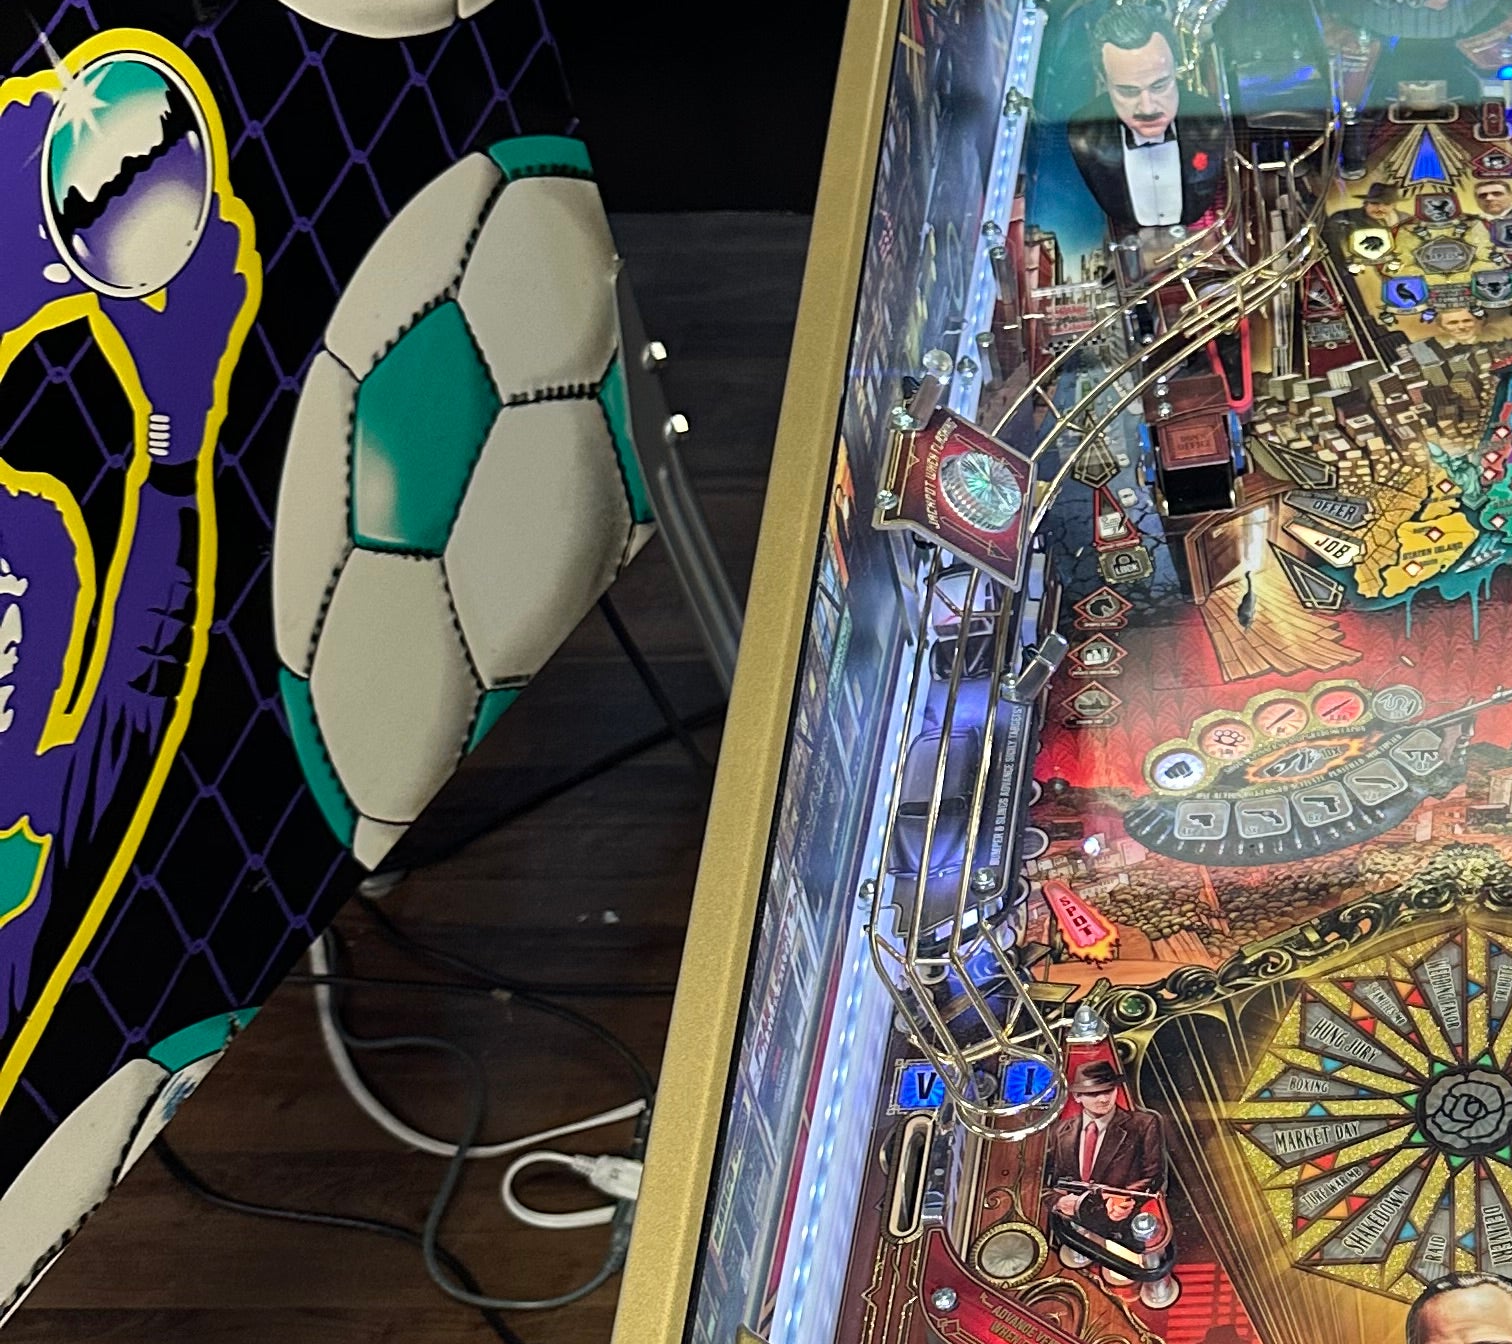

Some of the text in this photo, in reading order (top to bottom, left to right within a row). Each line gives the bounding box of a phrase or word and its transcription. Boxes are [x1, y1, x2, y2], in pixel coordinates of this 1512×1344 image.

[924, 454, 941, 529] JACKPOT WHEN
[1312, 498, 1357, 522] OFFER
[1313, 536, 1352, 560] JOB
[1114, 562, 1141, 577] LOCK
[1060, 896, 1092, 936] SPOT
[1423, 958, 1455, 999] WEDDING
[1308, 1018, 1379, 1063] HUNG JURY
[915, 1070, 936, 1102] V
[1023, 1066, 1035, 1096] I
[1288, 1076, 1330, 1094] BOXING
[1273, 1121, 1361, 1155] MARKET DAY
[1301, 1166, 1363, 1209] TURF WAR MB
[1342, 1184, 1412, 1256] SHAKEDOWN
[1422, 1234, 1446, 1264] RAID
[992, 1306, 1038, 1337] ADVANCE
